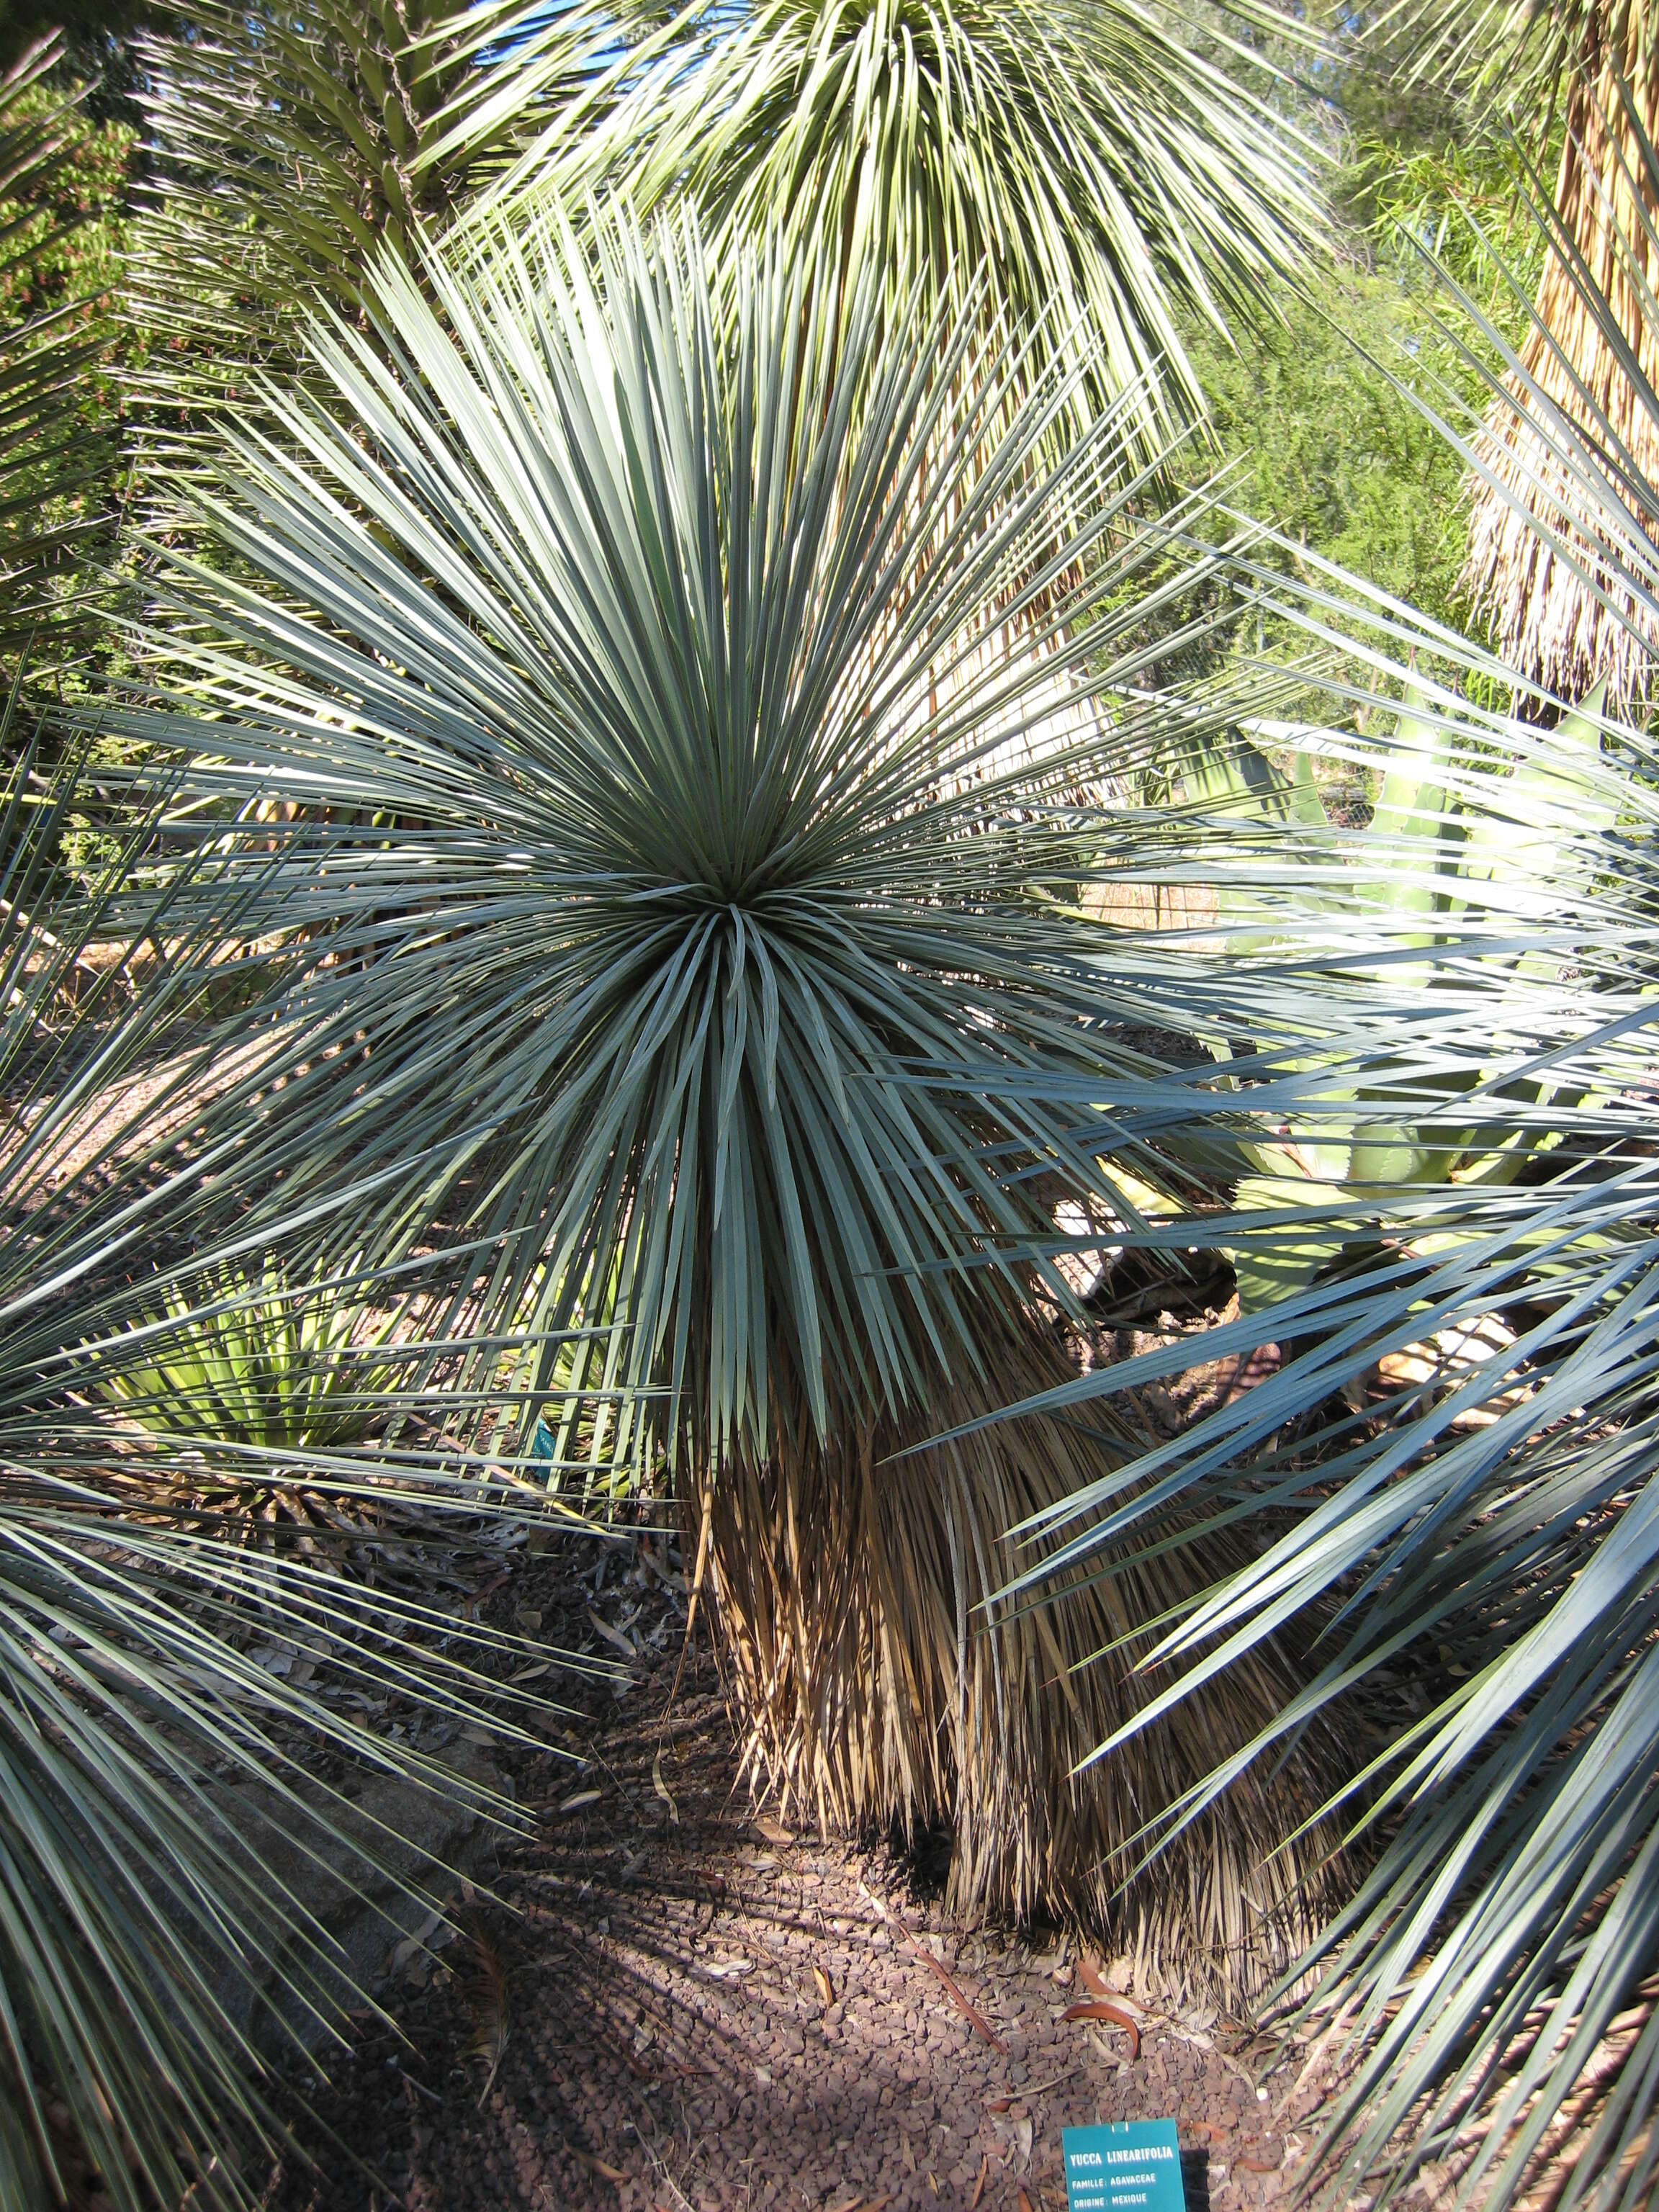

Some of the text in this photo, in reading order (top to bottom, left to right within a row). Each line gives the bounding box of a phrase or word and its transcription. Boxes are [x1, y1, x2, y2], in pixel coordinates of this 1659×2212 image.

[1070, 2146, 1173, 2167] YUCCA LINEARIFOLIA
[1110, 2173, 1156, 2186] AGAVACEAE
[1112, 2193, 1146, 2206] MEXIQUE
